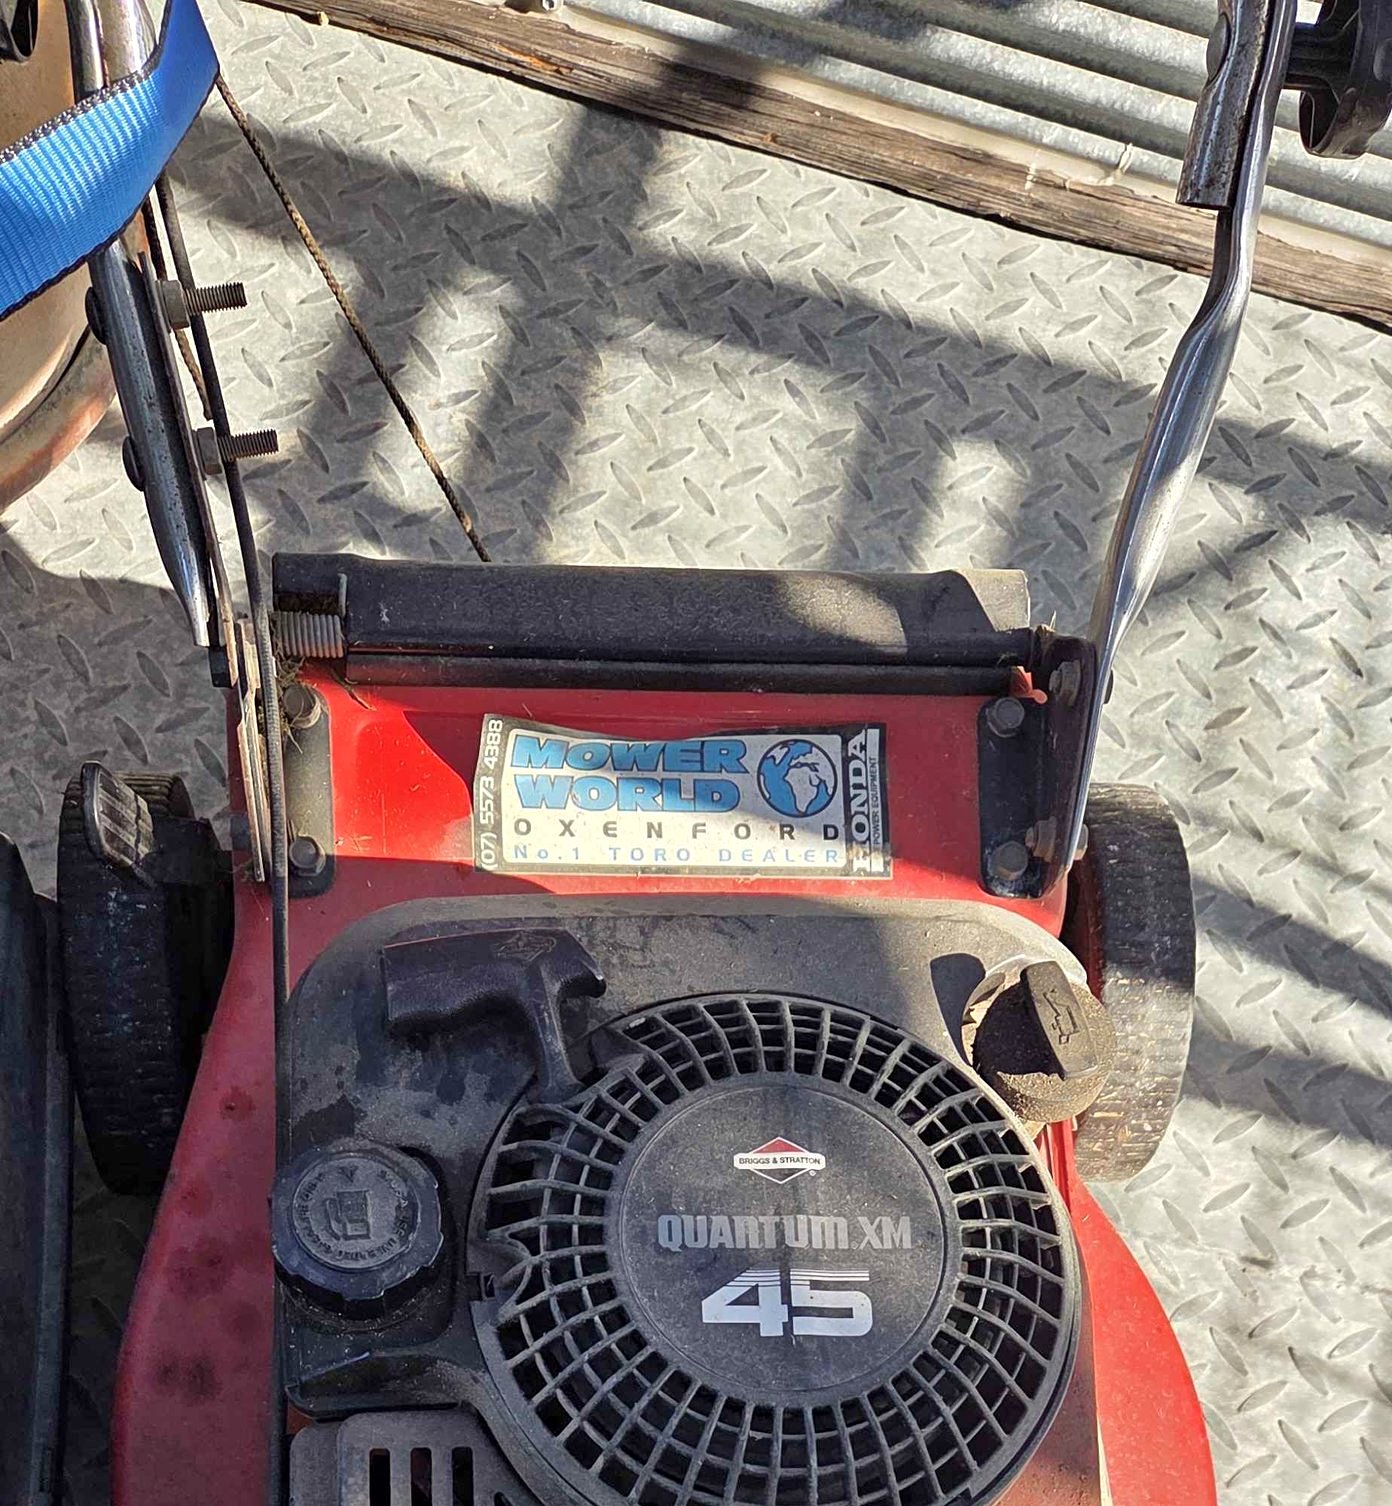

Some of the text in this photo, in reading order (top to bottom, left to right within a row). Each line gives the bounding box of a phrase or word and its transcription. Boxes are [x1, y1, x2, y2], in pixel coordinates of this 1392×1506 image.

[511, 734, 749, 774] MOWER
[479, 719, 503, 871] (07) 5573 4388
[514, 773, 741, 813] WORLD
[848, 729, 871, 872] HONDA
[869, 756, 881, 845] POWER EQUIPMENT
[513, 818, 840, 840] OXENFORD
[608, 846, 691, 862] TORO
[719, 849, 839, 864] DEALER
[739, 1157, 770, 1165] BRIGGS
[780, 1156, 821, 1165] STRATTON
[657, 1214, 912, 1252] QUANTUM XM
[701, 1268, 873, 1337] 45
